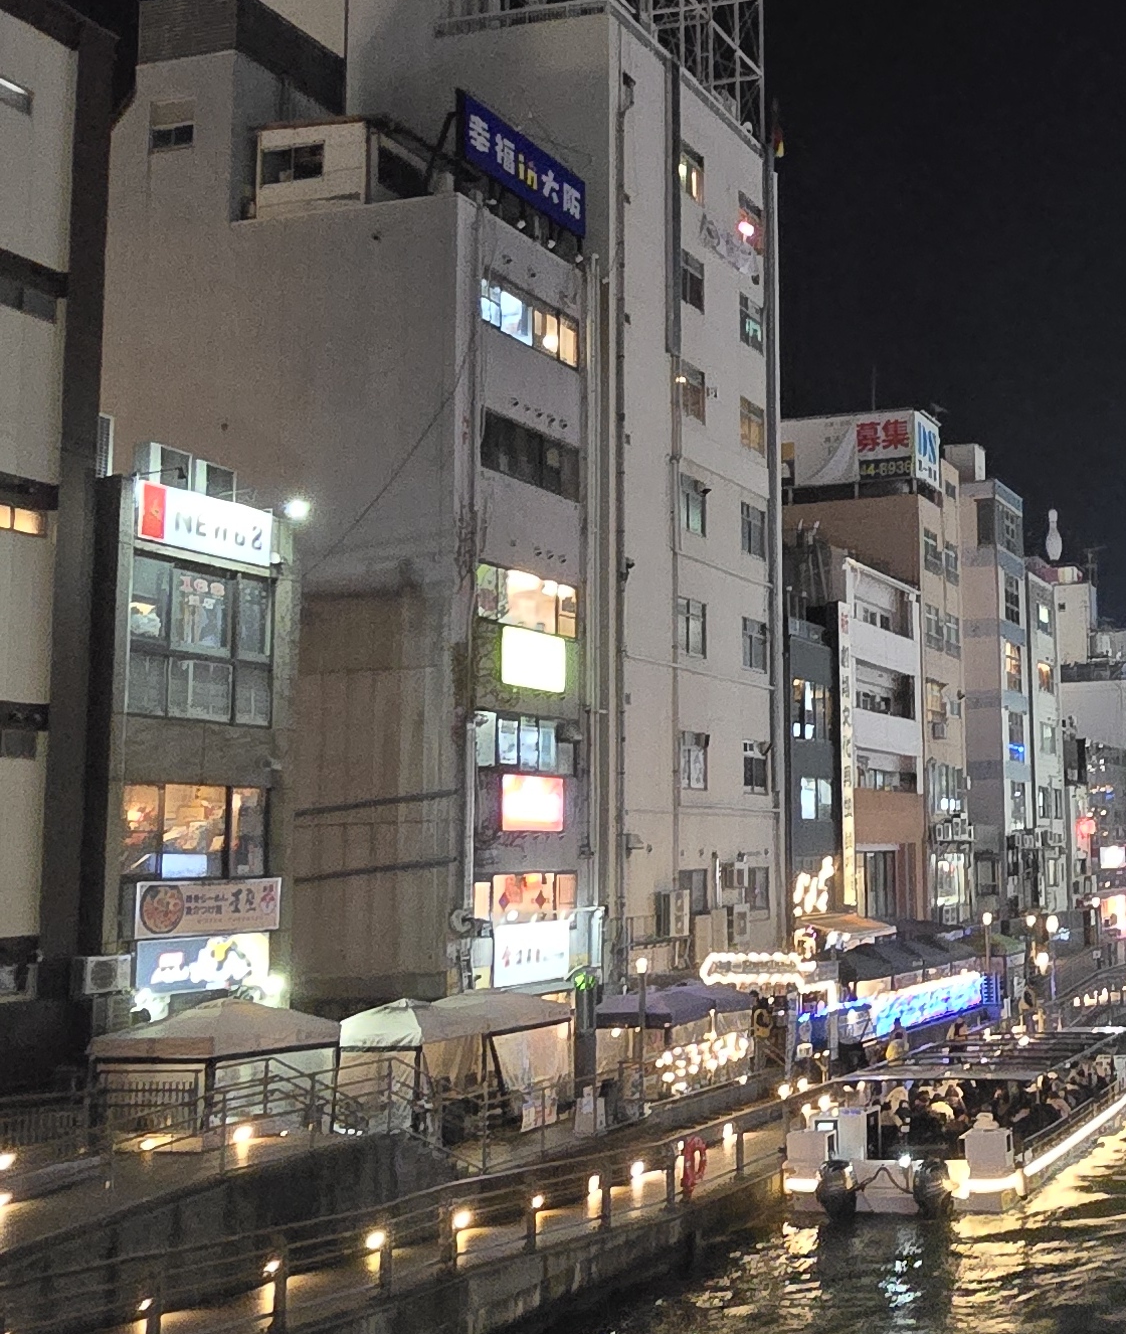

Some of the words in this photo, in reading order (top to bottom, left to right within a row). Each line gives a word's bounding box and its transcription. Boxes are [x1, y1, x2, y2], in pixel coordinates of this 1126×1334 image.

[468, 114, 581, 220] 幸福in大阪
[856, 419, 910, 453] 募集
